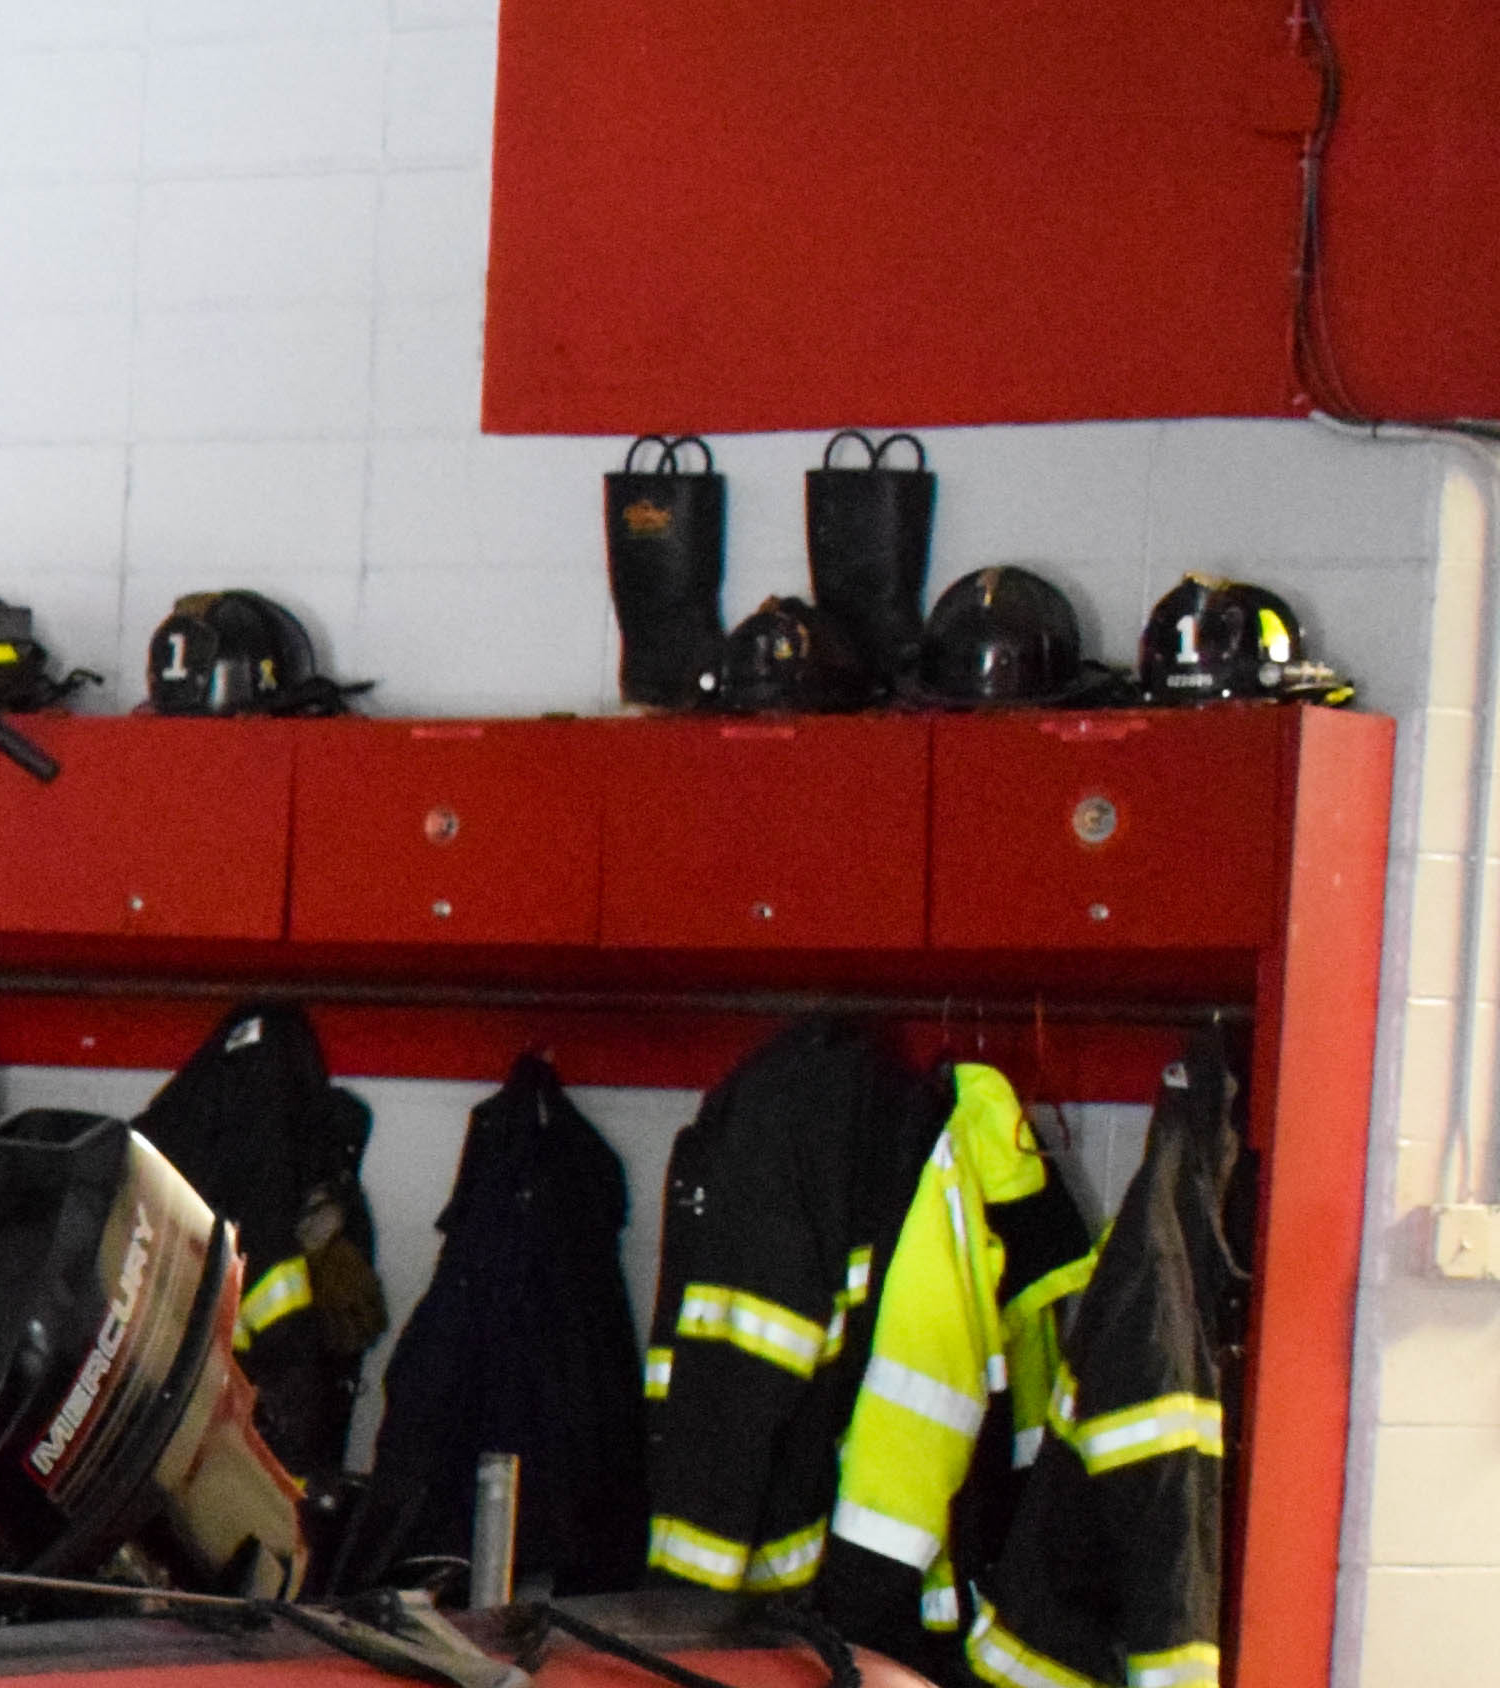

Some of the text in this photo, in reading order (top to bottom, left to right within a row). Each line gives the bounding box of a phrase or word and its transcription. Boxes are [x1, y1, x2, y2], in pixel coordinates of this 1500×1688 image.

[162, 632, 188, 680] 1
[1176, 614, 1199, 663] 1
[30, 1202, 153, 1476] MERCURY
